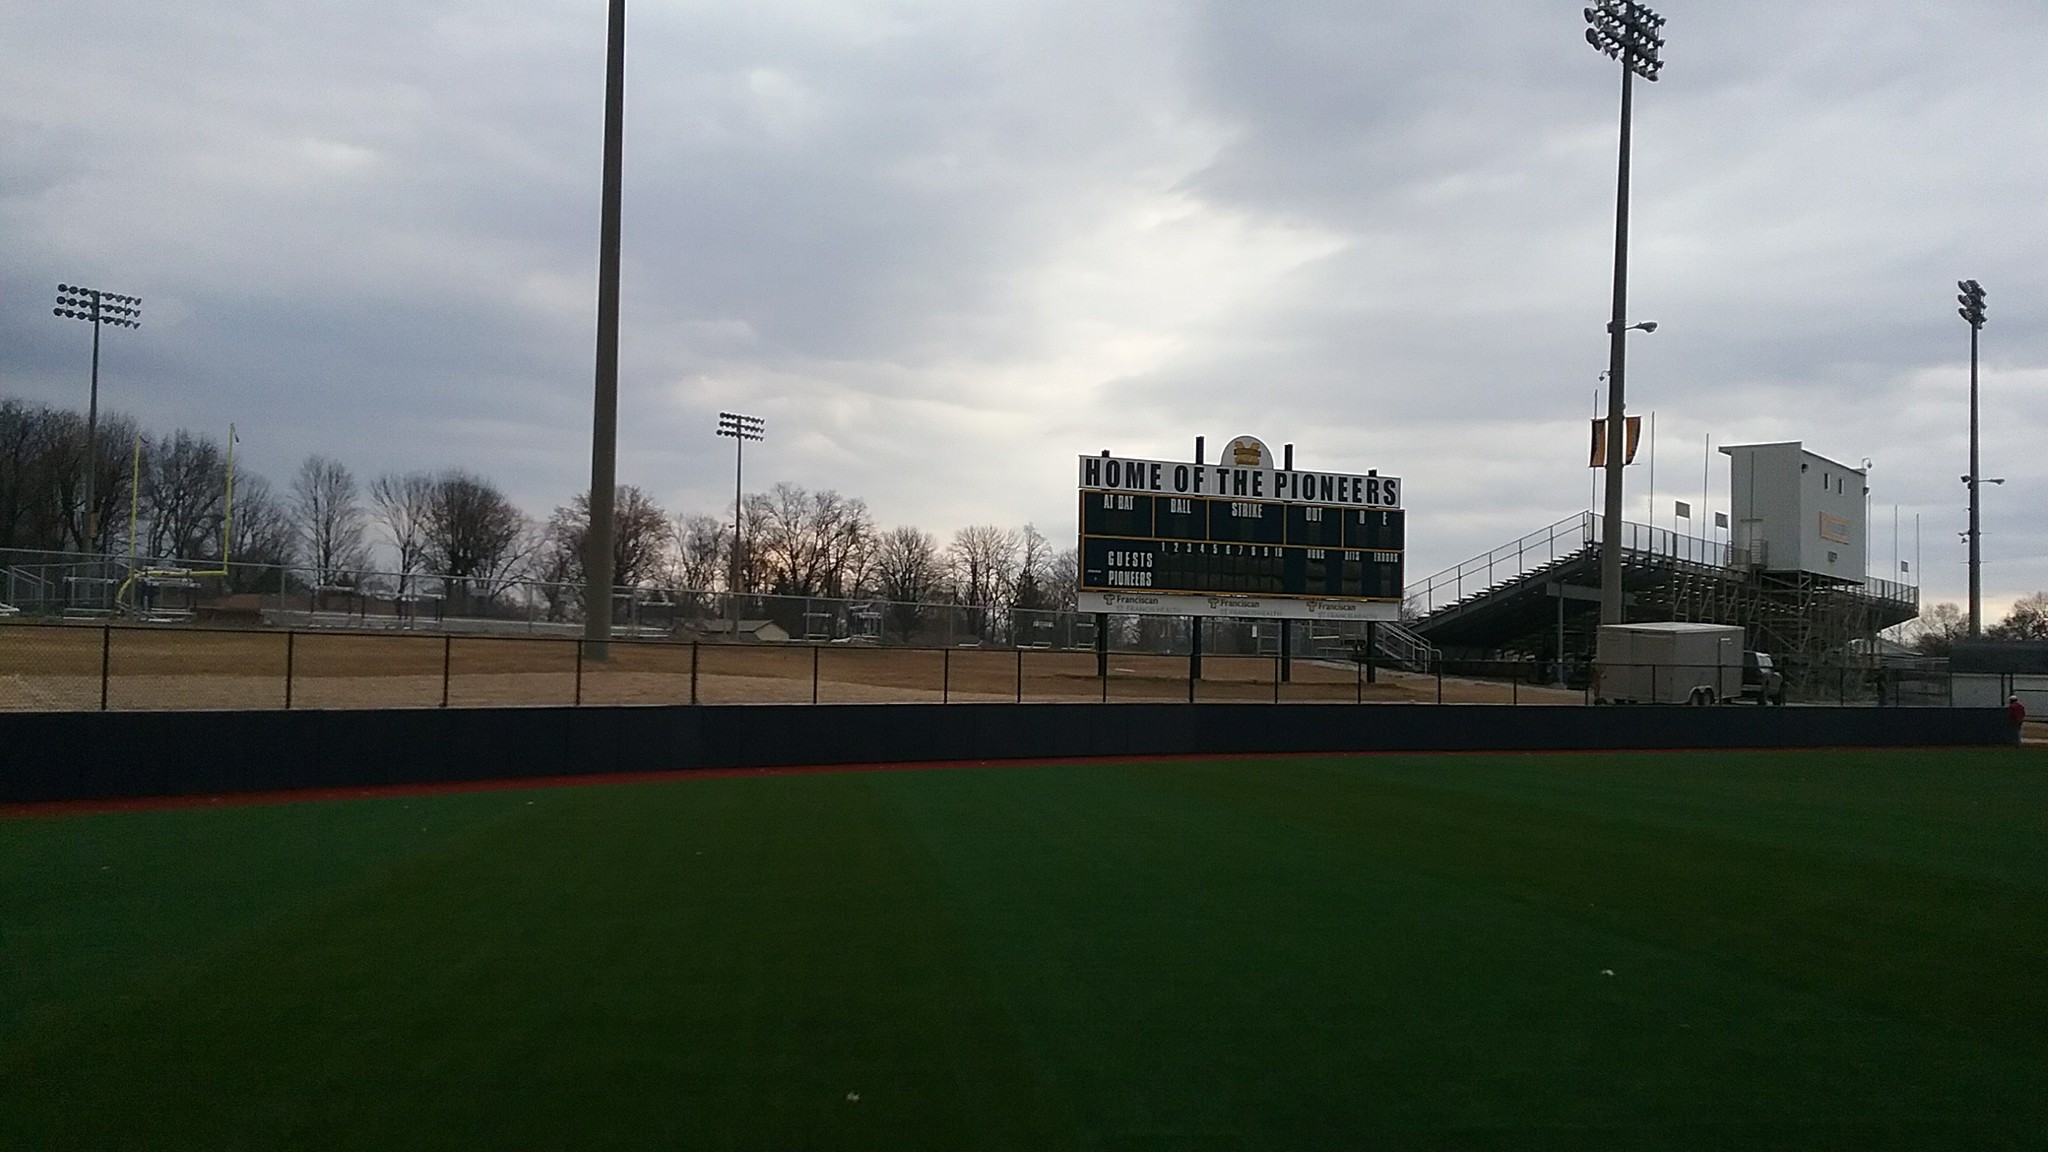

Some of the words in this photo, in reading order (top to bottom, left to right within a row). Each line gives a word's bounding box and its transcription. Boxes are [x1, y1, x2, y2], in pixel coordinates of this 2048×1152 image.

[1085, 458, 1162, 491] HOME
[1174, 465, 1204, 493] OF
[1216, 468, 1263, 497] THE
[1274, 472, 1396, 506] PIONEERS
[1103, 494, 1114, 509] AT
[1118, 495, 1134, 511] BAT
[1170, 498, 1192, 514] BALL
[1231, 502, 1263, 519] STRIKE
[1305, 507, 1323, 522] OUT
[1382, 511, 1388, 526] E
[1161, 542, 1165, 551] 1
[1174, 542, 1178, 552] 2
[1186, 543, 1191, 553] 3
[1200, 543, 1205, 553] 4
[1213, 544, 1217, 554] 5
[1238, 545, 1243, 555] 7
[1108, 550, 1153, 568] GUESTS
[1108, 570, 1152, 587] PIONEERS
[1116, 595, 1159, 605] Franciscan
[1220, 599, 1260, 608] Franciscan
[1318, 602, 1356, 611] Franciscan
